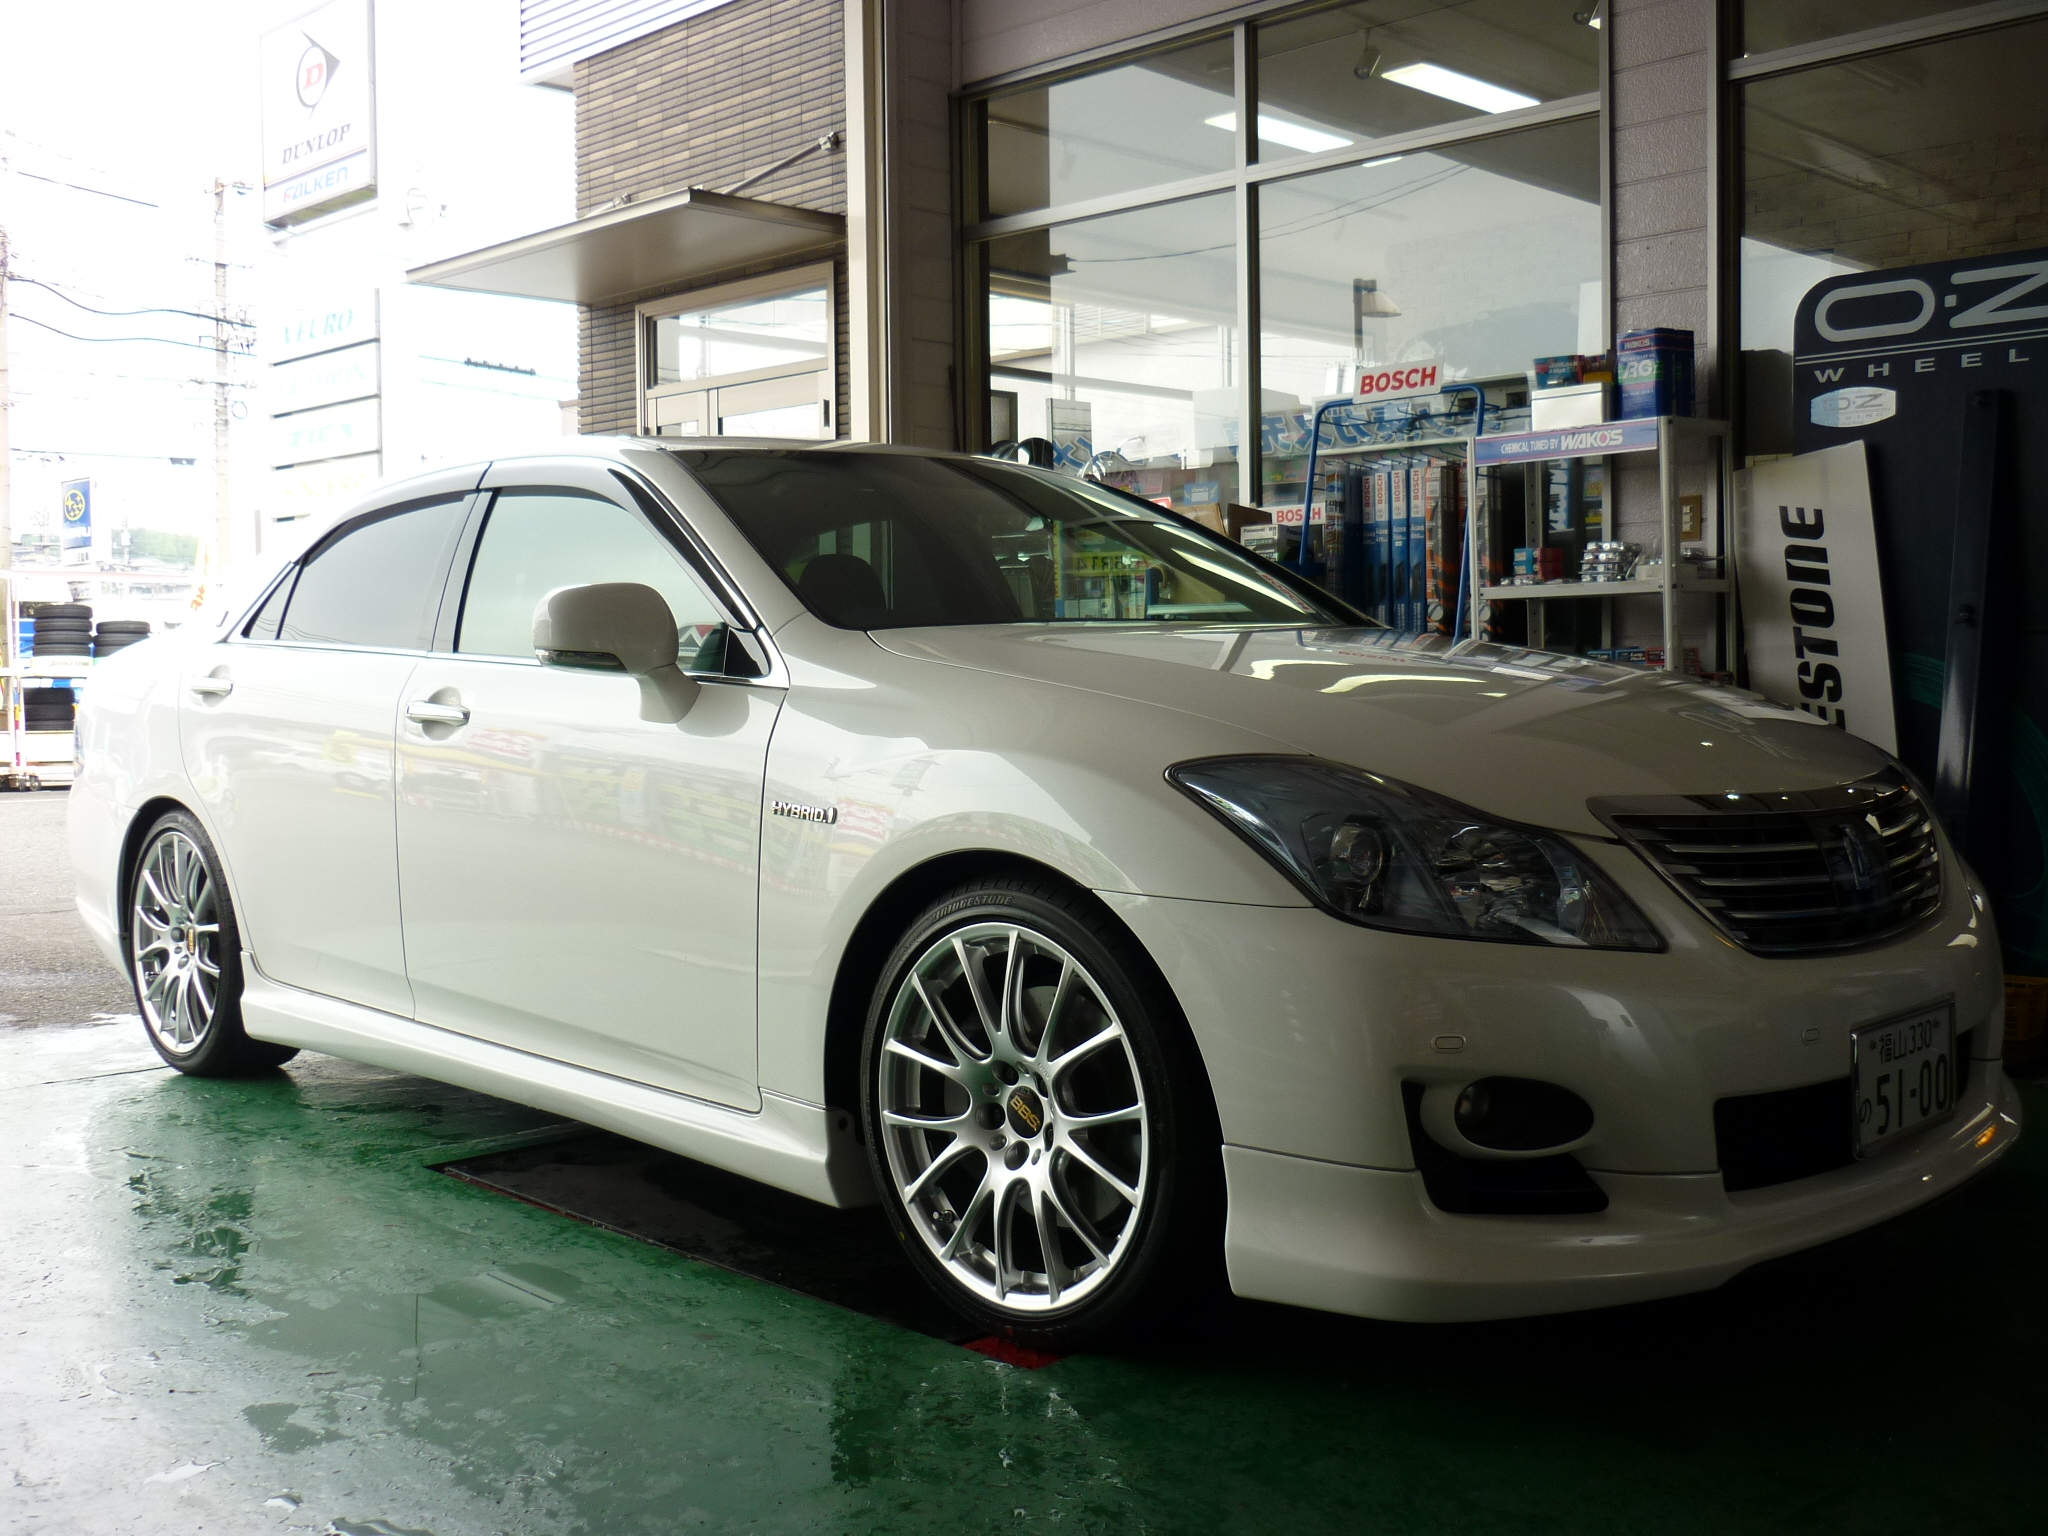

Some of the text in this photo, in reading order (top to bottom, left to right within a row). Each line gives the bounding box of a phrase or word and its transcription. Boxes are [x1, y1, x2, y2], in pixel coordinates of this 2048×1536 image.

[282, 123, 351, 165] DUNLOP
[283, 166, 348, 203] FALKEN
[1359, 366, 1438, 395] BOSCH
[1500, 442, 1529, 455] CHEMICAL
[1530, 440, 1548, 451] TUNED
[1549, 438, 1559, 450] BY
[1412, 470, 1420, 501] BOSCH
[1276, 507, 1321, 523] BOSH
[772, 801, 826, 823] HYBRID
[931, 894, 1014, 922] BRIDGESTONE
[1876, 1053, 1948, 1135] 51-00
[1010, 1095, 1041, 1132] BBS
